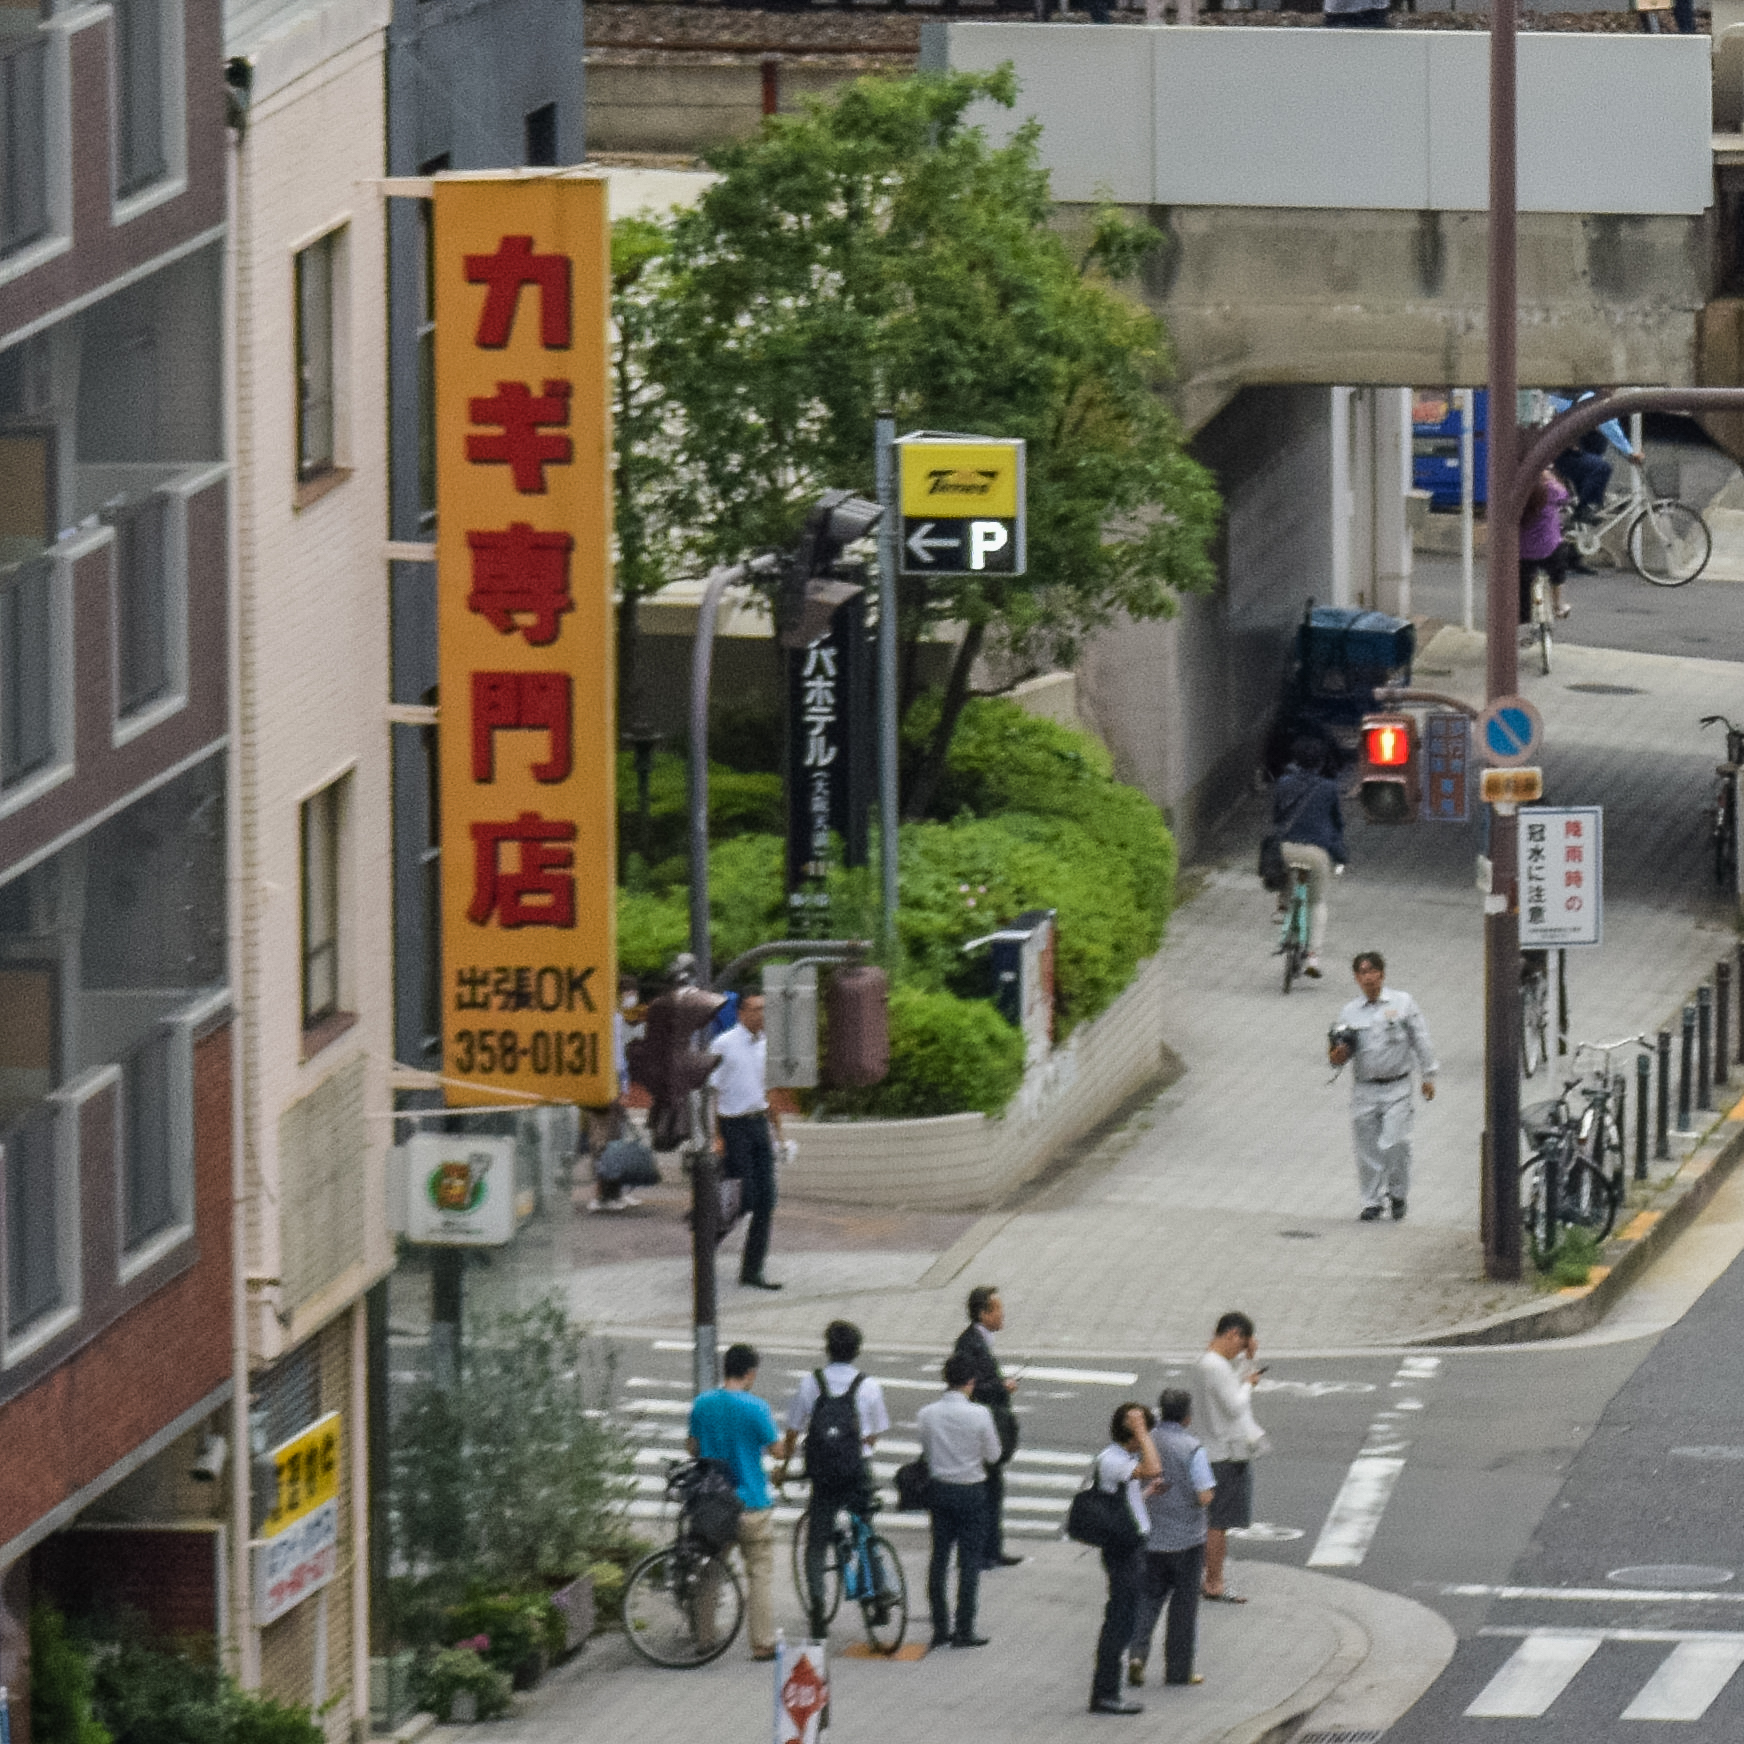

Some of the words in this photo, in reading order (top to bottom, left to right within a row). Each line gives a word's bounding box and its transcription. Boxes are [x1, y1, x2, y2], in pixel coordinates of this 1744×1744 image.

[970, 520, 1008, 570] P
[463, 234, 577, 930] カギ専門店
[802, 633, 838, 767] パホテル
[455, 965, 598, 1014] 出張OK
[455, 1027, 600, 1078] 358-0131
